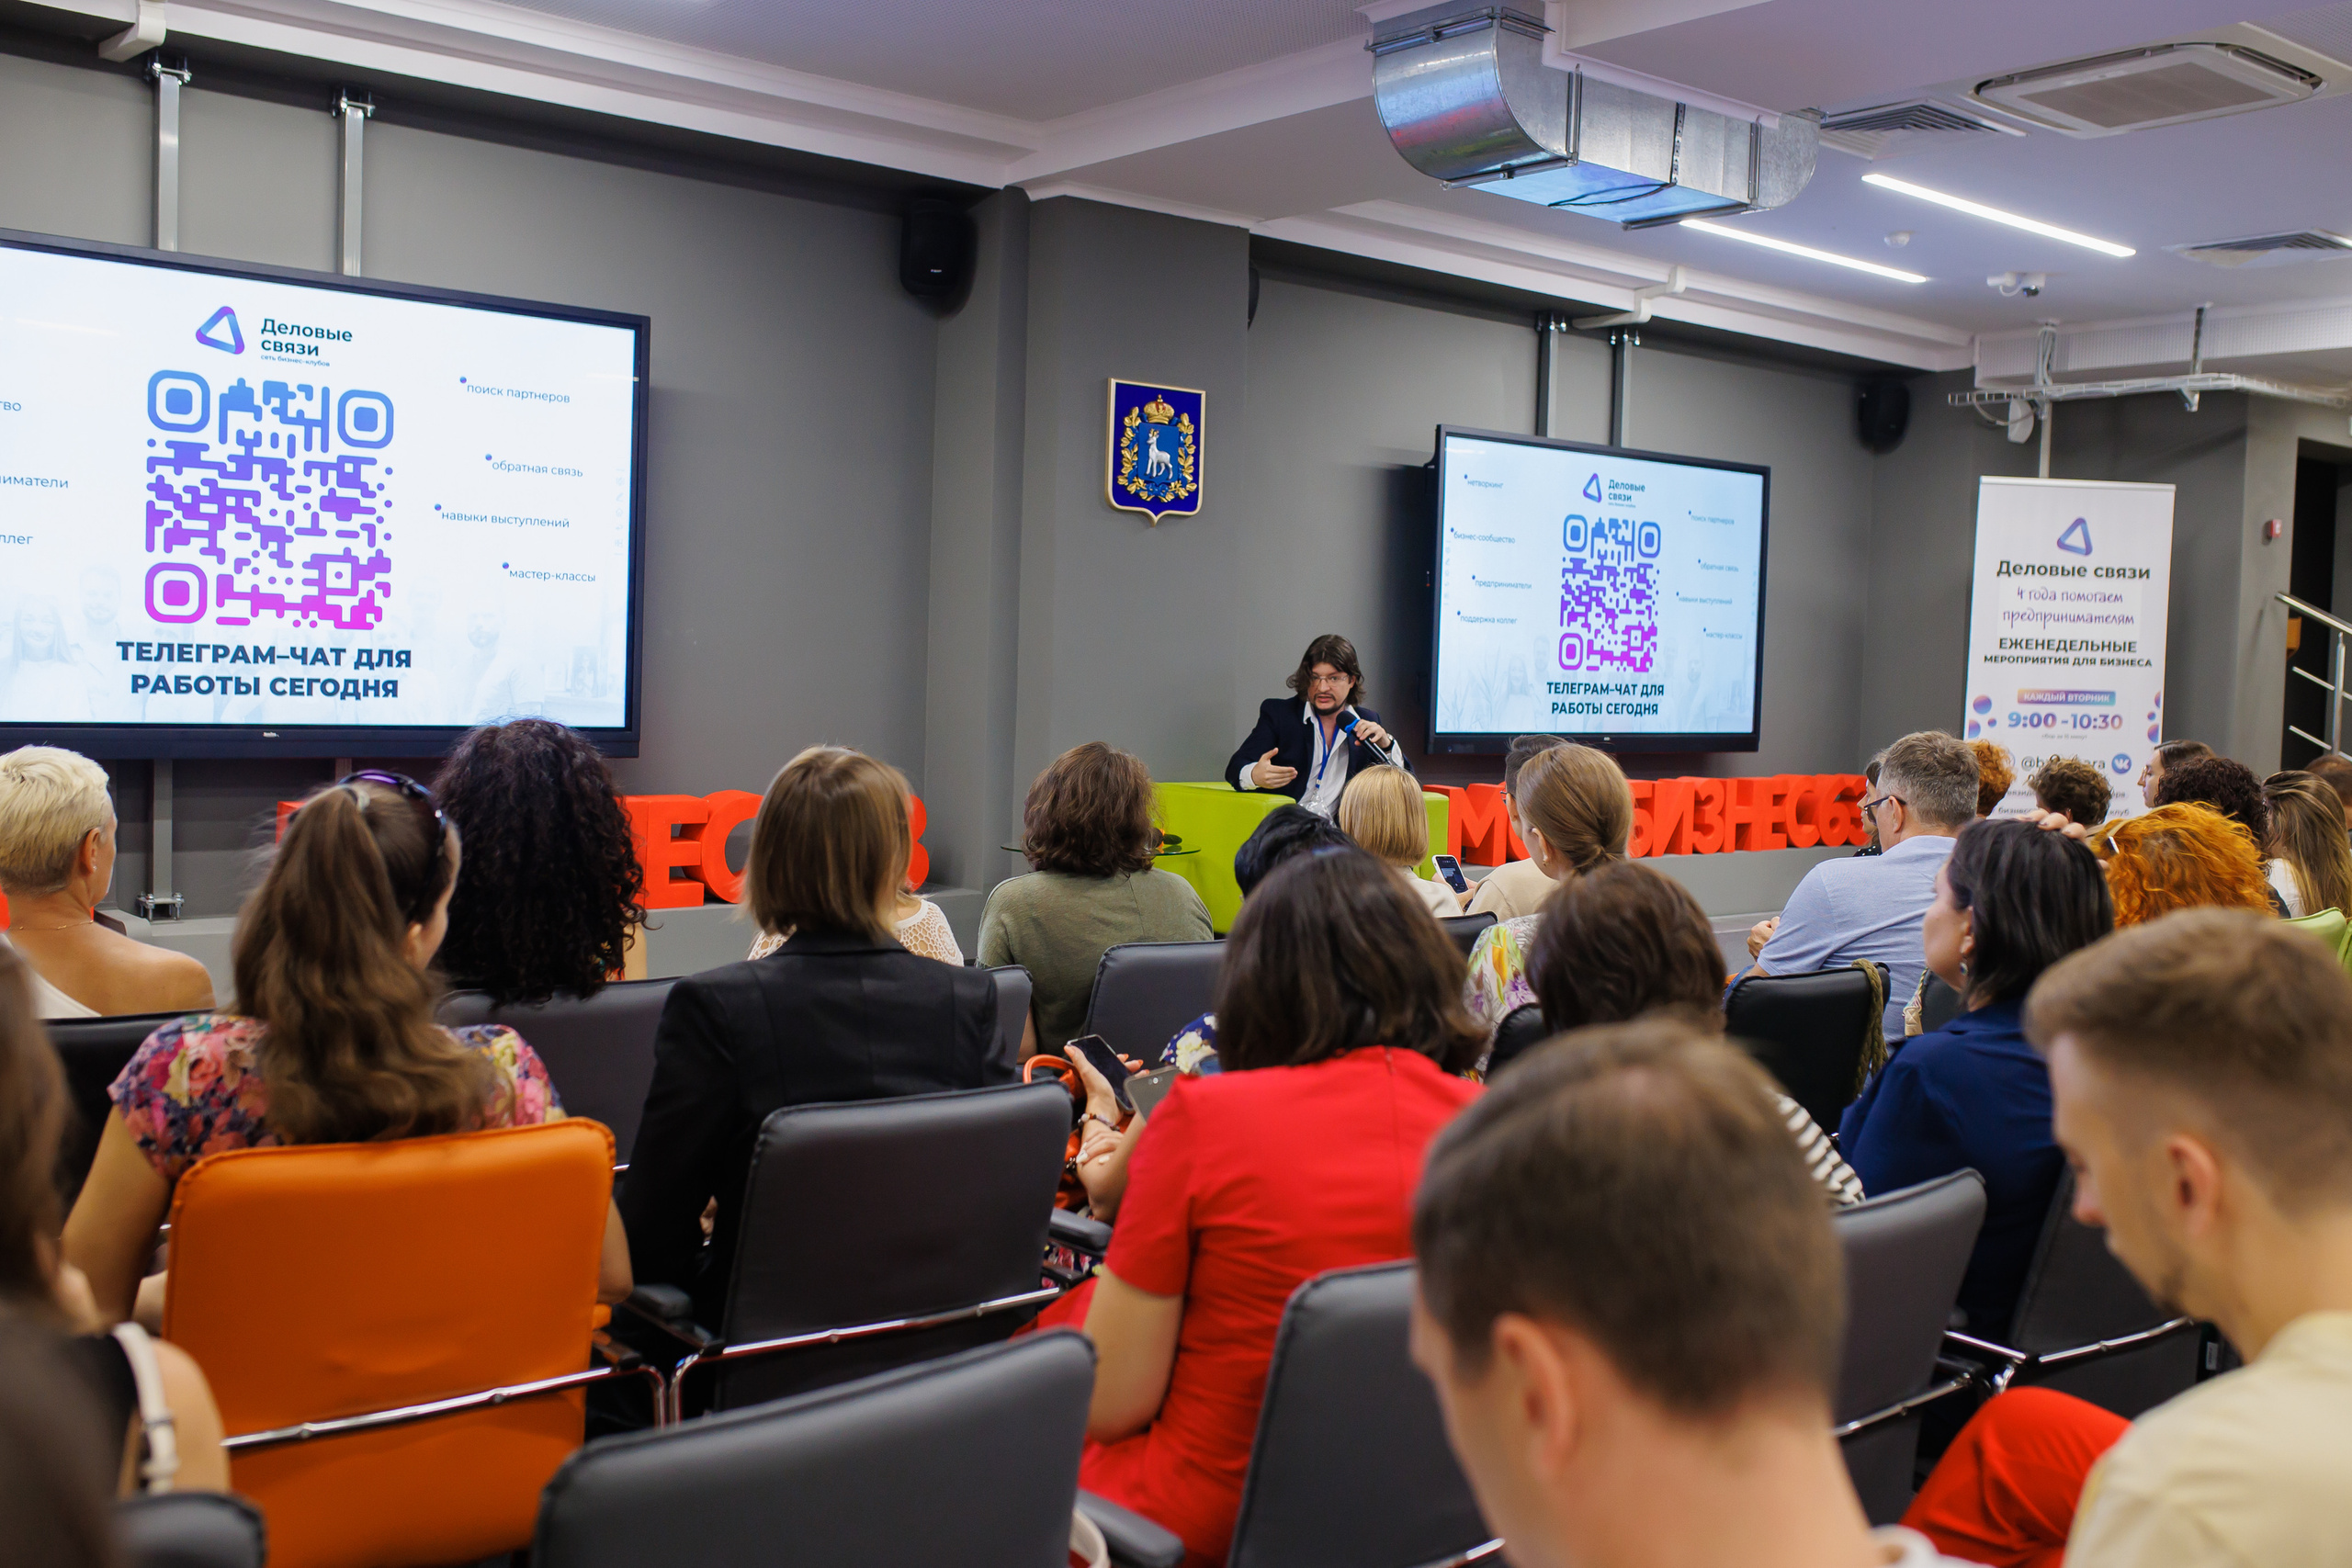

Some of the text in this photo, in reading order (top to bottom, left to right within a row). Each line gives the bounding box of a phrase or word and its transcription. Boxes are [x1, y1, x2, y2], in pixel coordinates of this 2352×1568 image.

[260, 317, 353, 342] Деловые
[261, 339, 319, 356] связи
[277, 355, 331, 367] бизнес-клубов
[467, 384, 571, 403] поиск партнеров
[492, 460, 583, 478] обратная связь
[0, 475, 69, 489] иматели
[1467, 479, 1504, 490] нетворкинг
[1608, 479, 1646, 492] Деловые
[1608, 492, 1633, 502] связи
[441, 512, 571, 528] навыки выступлений
[1453, 531, 1516, 544] бизнес-сообщество
[509, 570, 596, 582] мастер-классы
[1996, 560, 2151, 580] Деловые связи
[1475, 580, 1532, 590] предприниматели
[2017, 586, 2123, 603] 4 года помогаем
[1460, 615, 1496, 625] поддержка
[2003, 607, 2134, 630] предпринимателям
[1998, 637, 2138, 653] ЕЖЕНЕДЕЛЬНЫЕ
[354, 648, 412, 671] ДЛЯ
[1984, 654, 2153, 668] МЕРОПРИЯТИЯ ДЛЯ БИЗНЕСА
[130, 673, 399, 701] РАБОТЫ СЕГОДНЯ
[1640, 684, 1665, 698] ДЛЯ
[2023, 691, 2110, 703] КАЖДЫЙ ВТОРНИК
[1551, 702, 1658, 717] РАБОТЫ СЕГОДНЯ
[2007, 712, 2057, 728] 9:00
